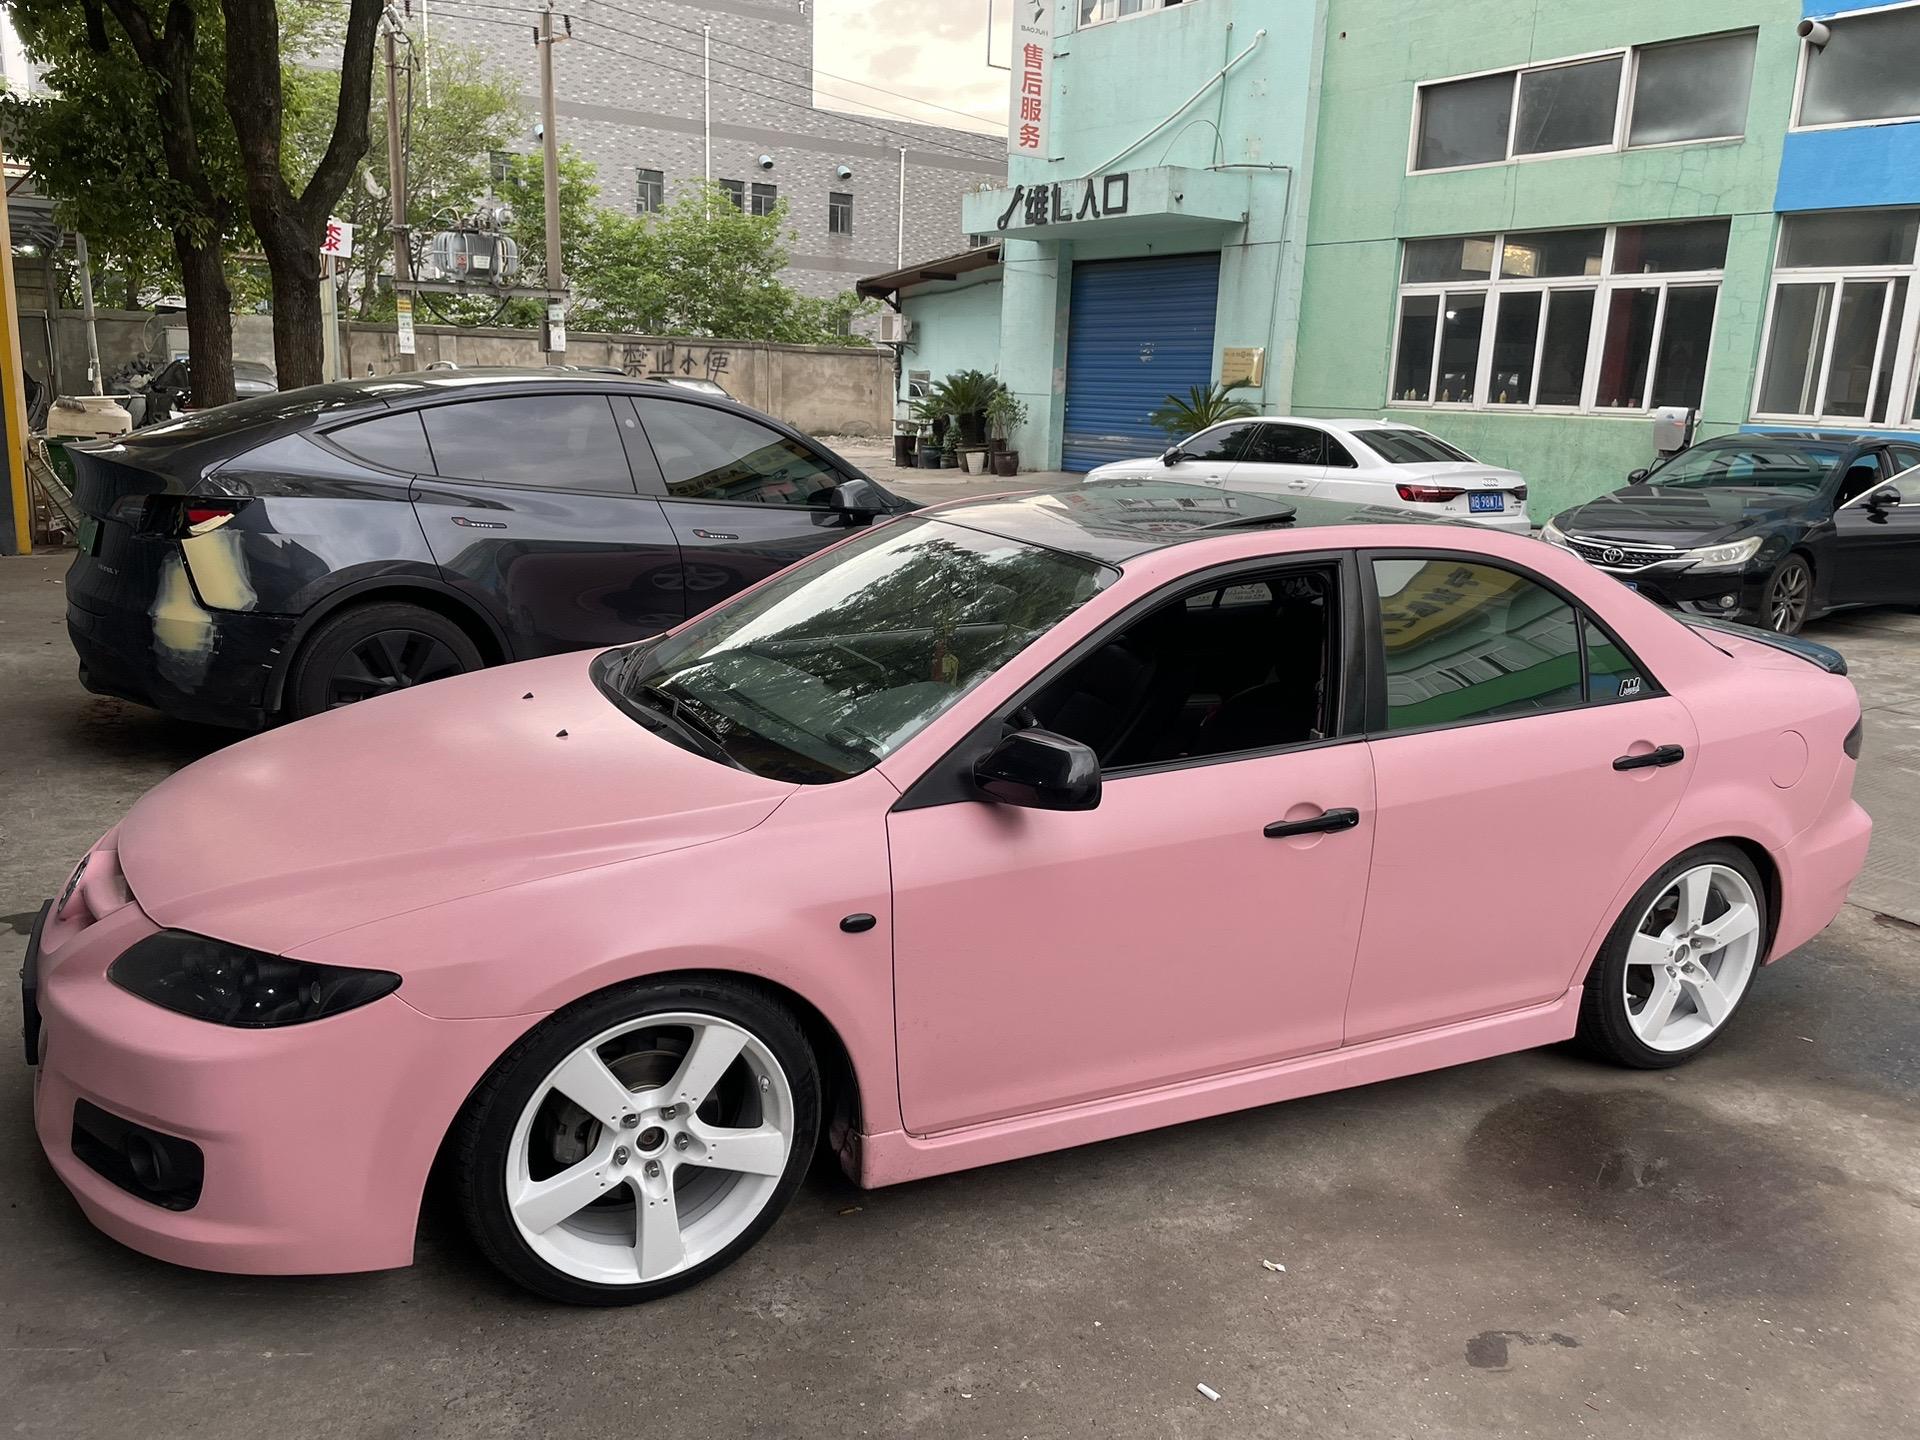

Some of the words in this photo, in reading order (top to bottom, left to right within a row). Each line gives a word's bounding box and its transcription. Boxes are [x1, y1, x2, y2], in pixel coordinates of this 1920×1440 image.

[1018, 43, 1044, 149] 售后服务
[1024, 172, 1129, 225] 维入口
[623, 342, 731, 381] 禁止小便
